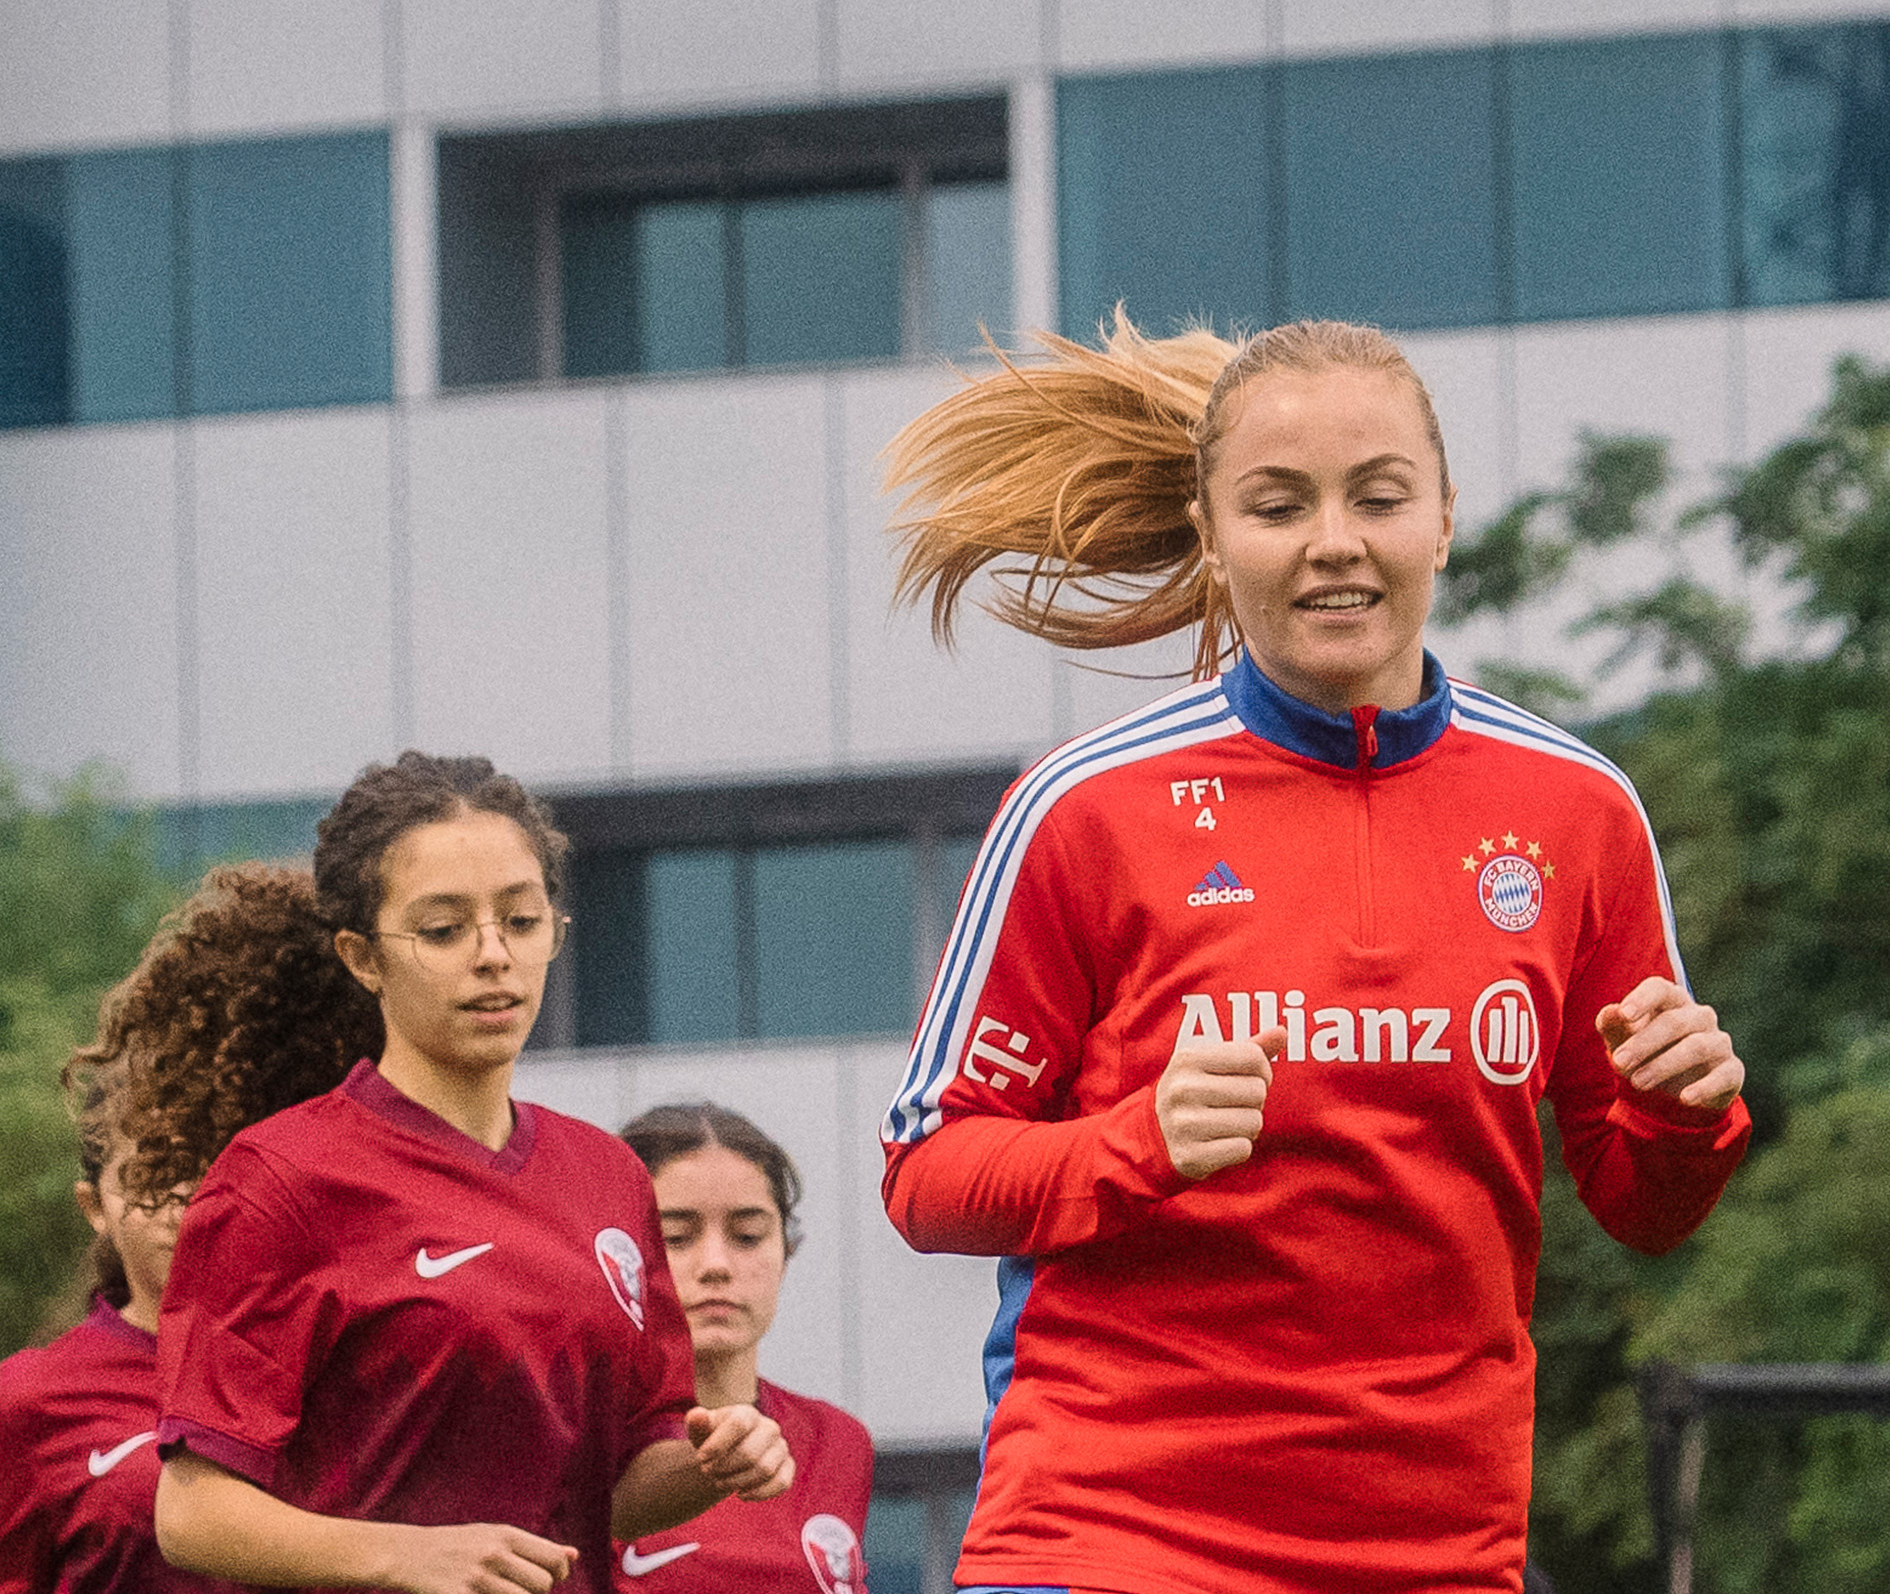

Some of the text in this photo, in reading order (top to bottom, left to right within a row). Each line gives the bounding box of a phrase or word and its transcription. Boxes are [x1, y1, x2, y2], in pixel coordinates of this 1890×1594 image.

[1171, 777, 1225, 806] FF1
[1195, 807, 1217, 831] 4
[1484, 861, 1540, 891] FC BAYERN
[1187, 887, 1255, 907] adidas
[1174, 990, 1452, 1063] Allianz
